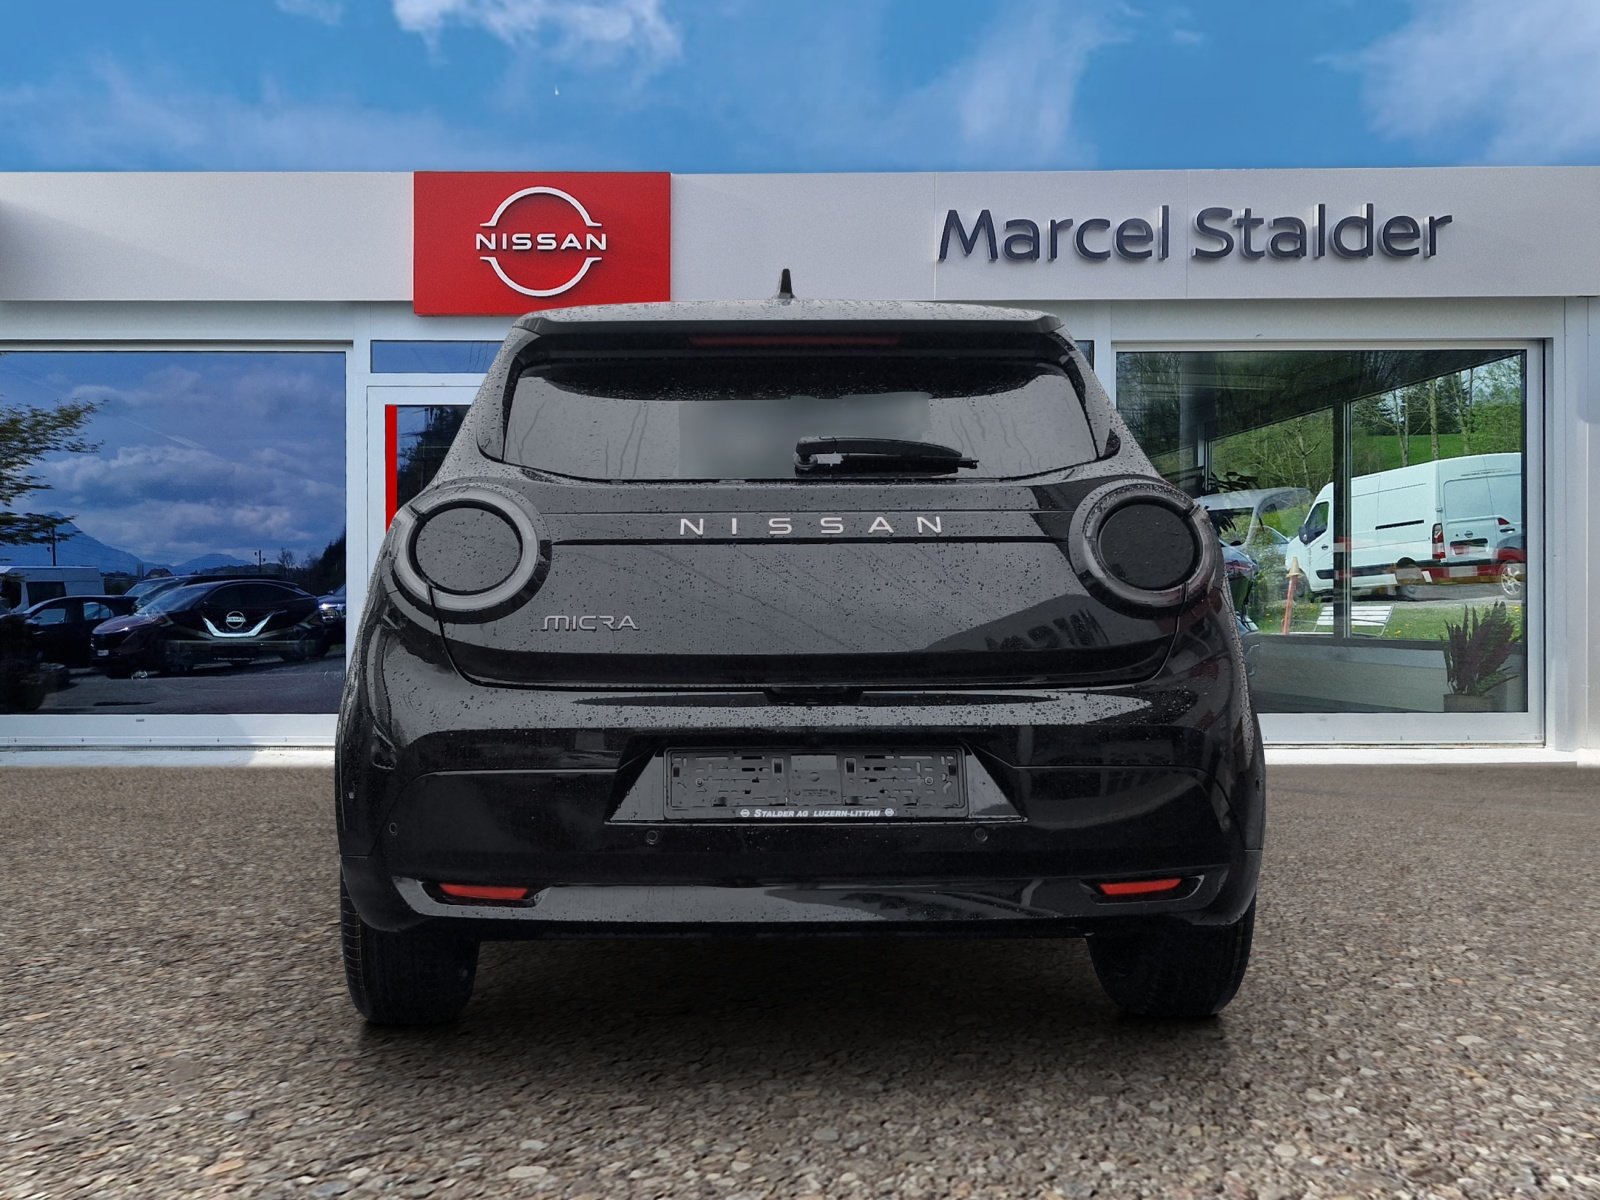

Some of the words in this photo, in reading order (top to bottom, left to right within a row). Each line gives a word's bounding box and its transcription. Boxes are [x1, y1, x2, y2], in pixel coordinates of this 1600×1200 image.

[937, 204, 1169, 262] Marcel
[1191, 203, 1453, 259] Stalder
[475, 233, 607, 250] NISSAN
[679, 516, 943, 535] NISSAN
[541, 615, 640, 630] MICRA
[753, 808, 795, 818] STALDER
[813, 809, 881, 817] LUZERN-LITTAU
